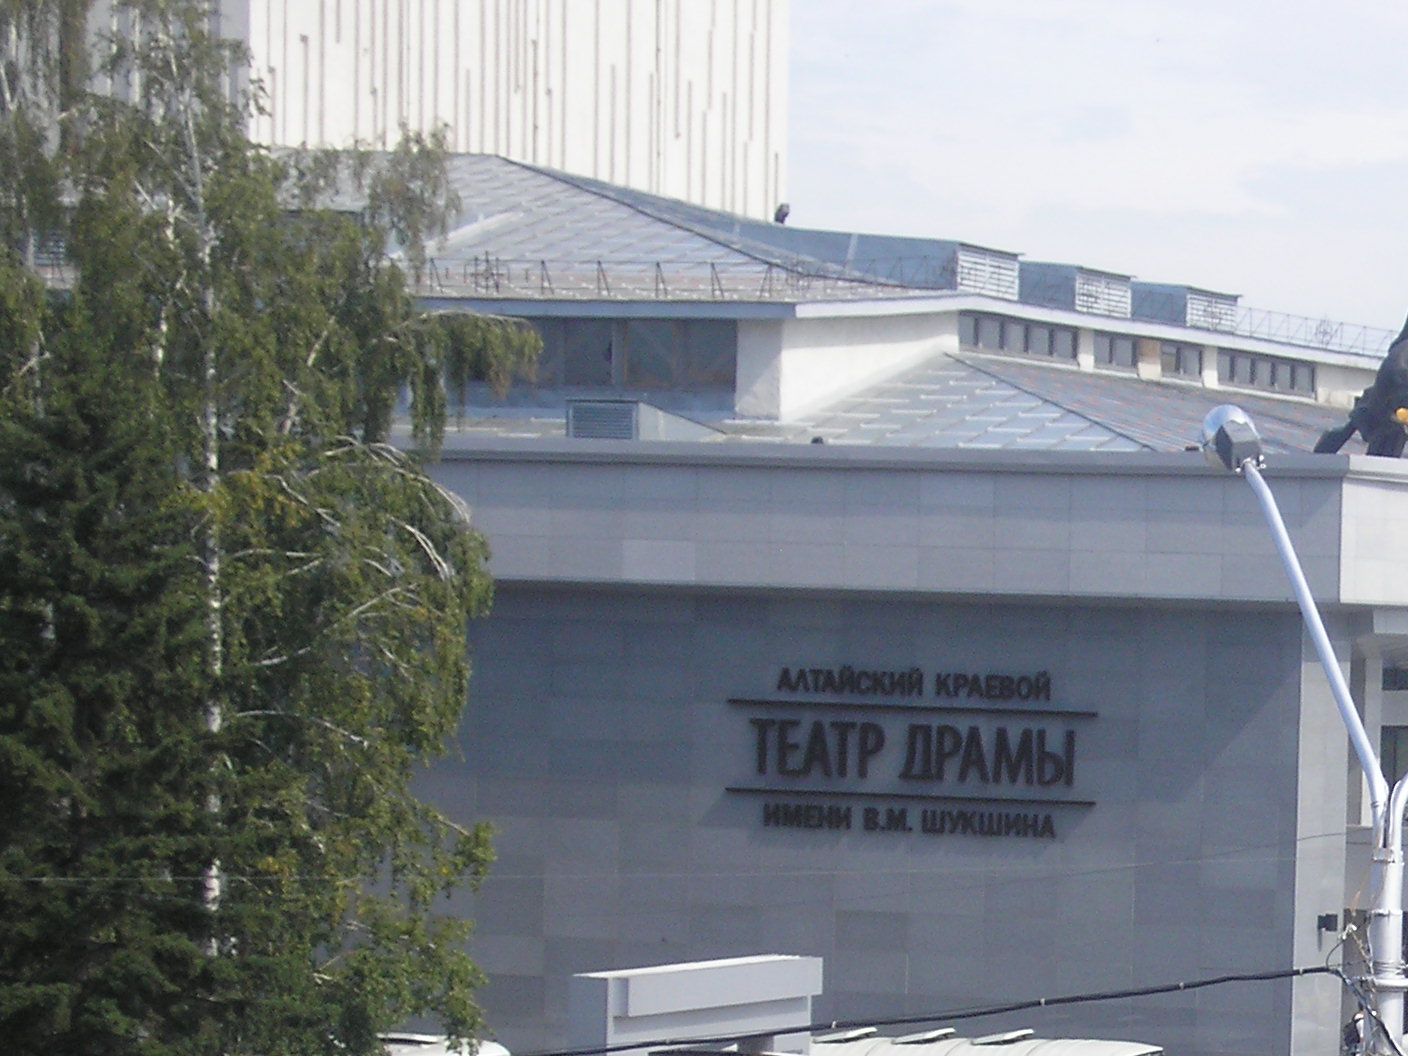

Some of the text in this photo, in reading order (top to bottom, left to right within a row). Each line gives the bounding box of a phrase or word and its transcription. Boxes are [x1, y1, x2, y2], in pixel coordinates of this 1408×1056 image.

[776, 664, 1052, 701] АЛТАЙСКИЙ КРАЕВОЙ
[749, 717, 1076, 788] ТЕАТР ДРАМЫ
[762, 803, 1056, 839] ИМЕНИ В.М. ШУКШИНА
